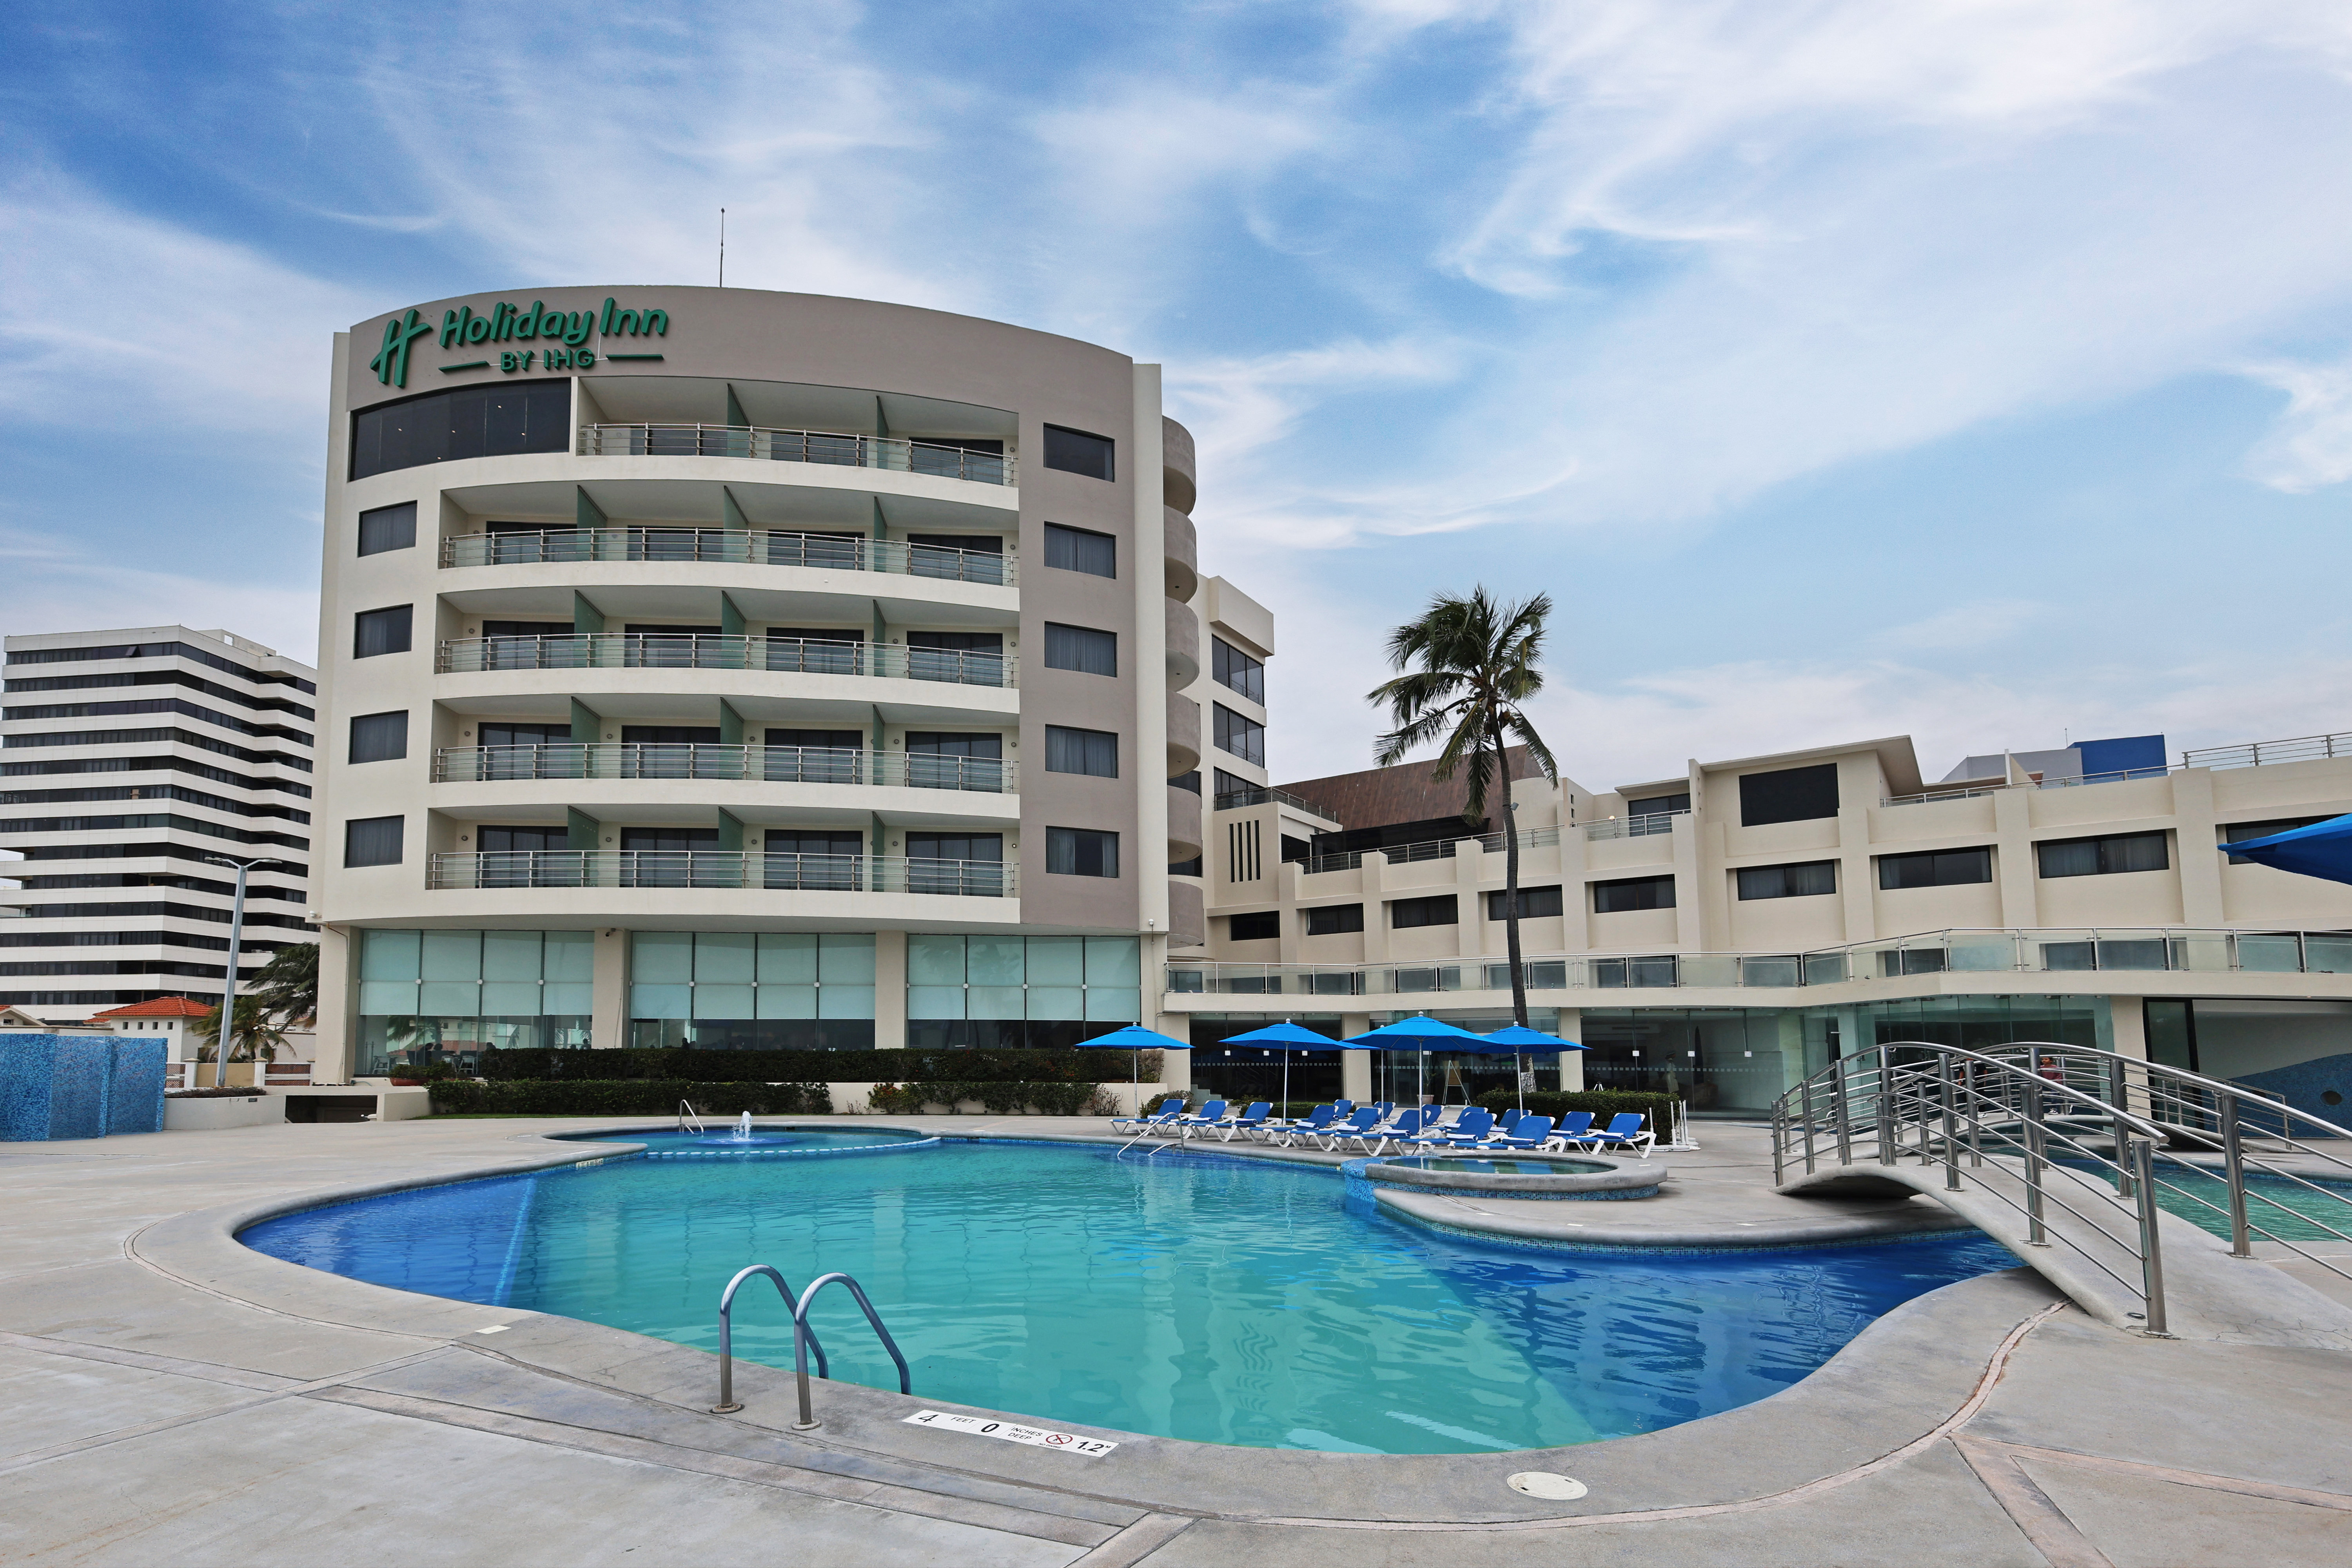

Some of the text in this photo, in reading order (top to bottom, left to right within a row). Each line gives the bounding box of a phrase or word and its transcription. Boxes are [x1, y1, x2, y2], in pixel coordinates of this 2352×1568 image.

[439, 297, 668, 348] Holiday Inn
[501, 348, 595, 373] BY IHG
[918, 1414, 939, 1423] 4
[981, 1423, 1000, 1432] 0
[1011, 1427, 1043, 1436] INCHES
